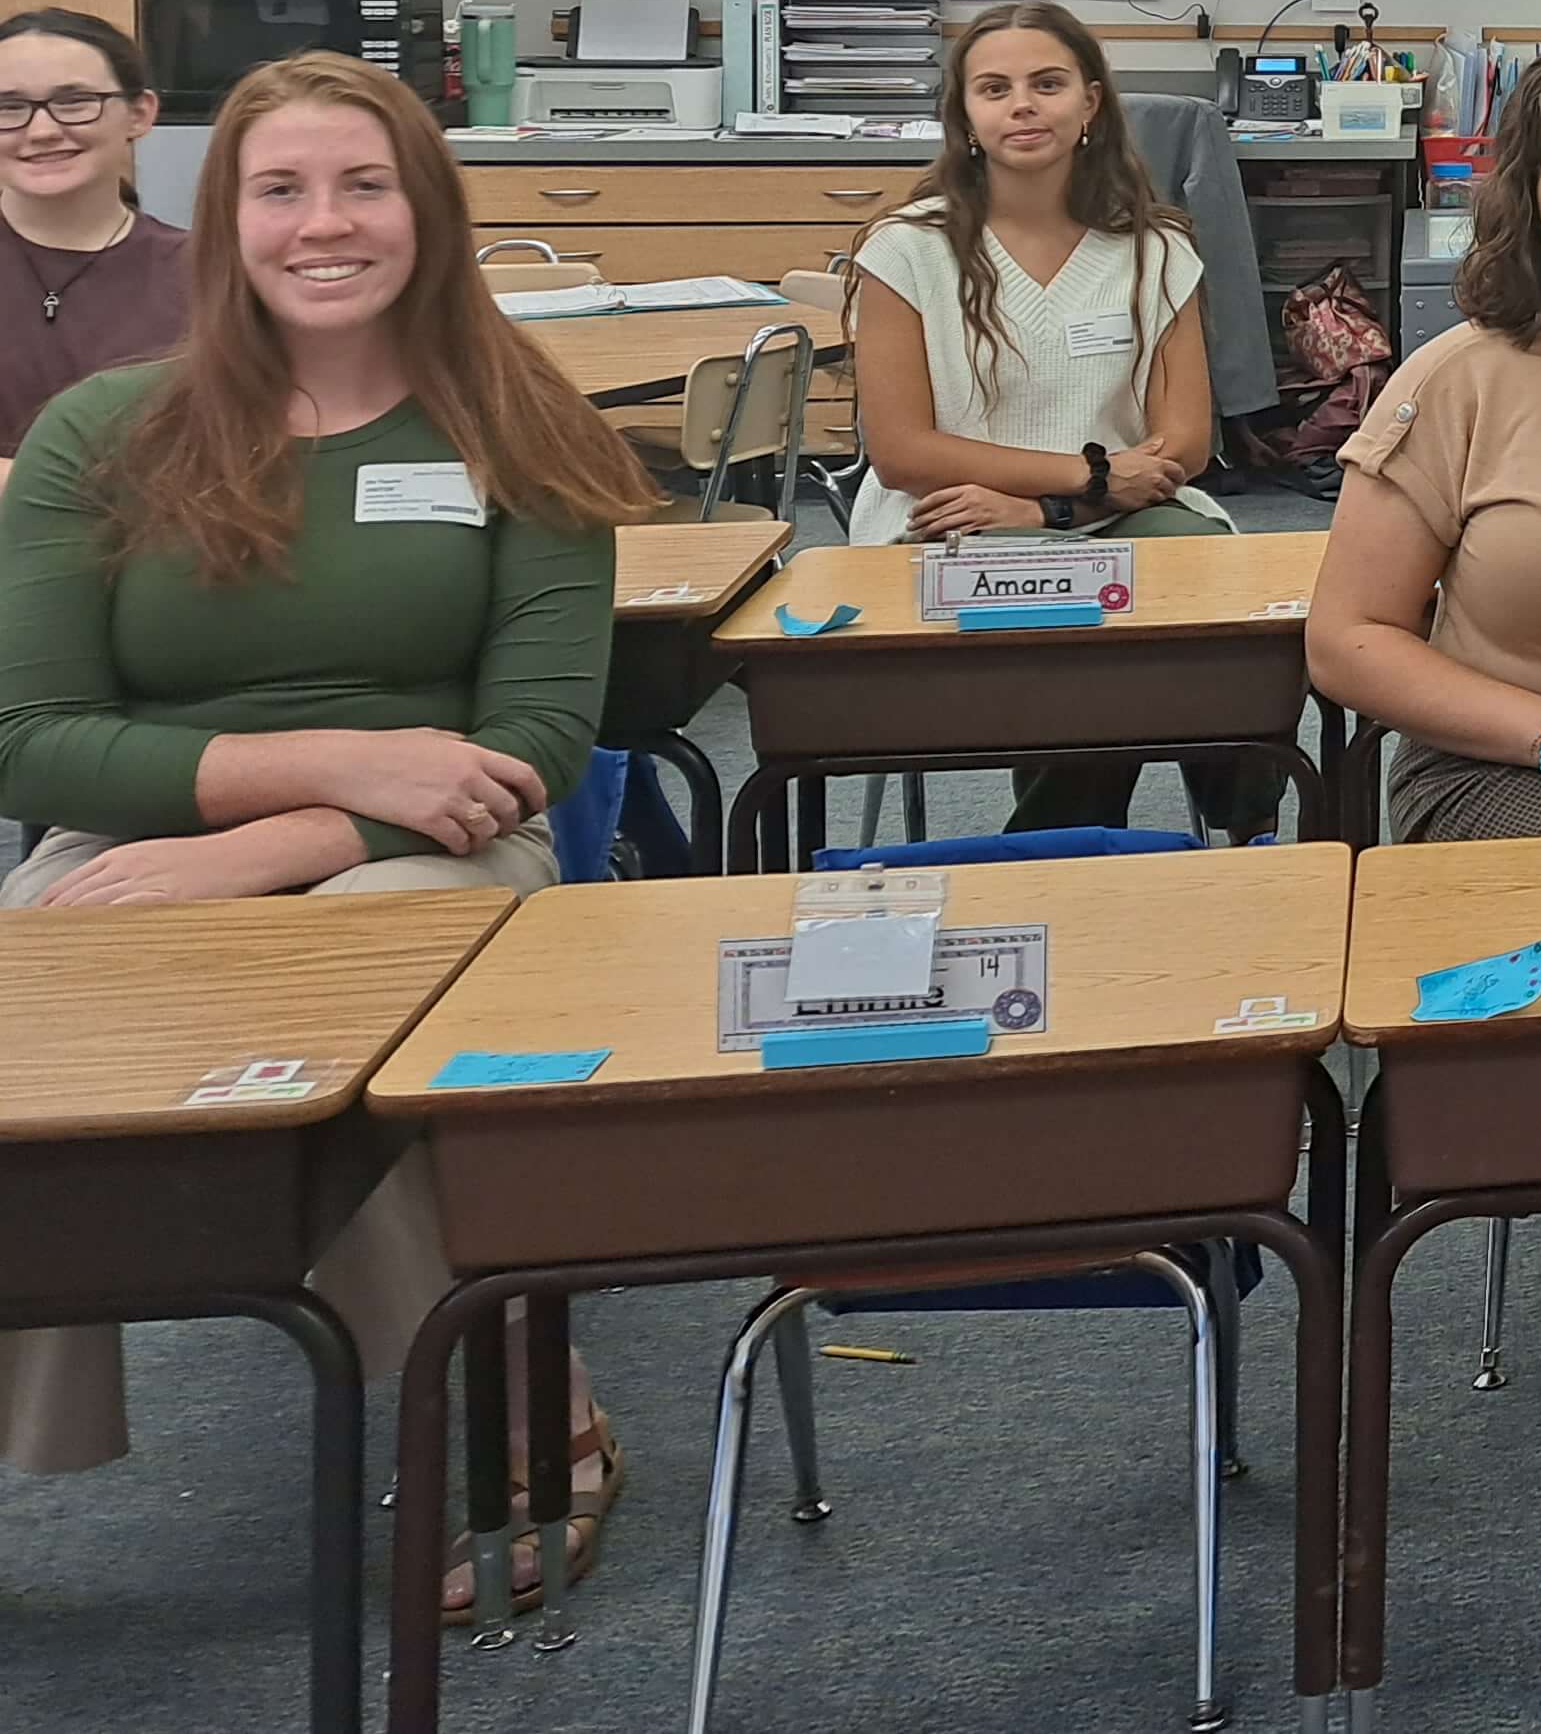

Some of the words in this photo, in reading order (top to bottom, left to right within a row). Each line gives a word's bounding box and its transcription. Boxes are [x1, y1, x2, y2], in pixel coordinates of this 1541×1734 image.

[1092, 562, 1107, 573] 10
[971, 570, 1073, 597] Amara
[981, 955, 999, 978] 14
